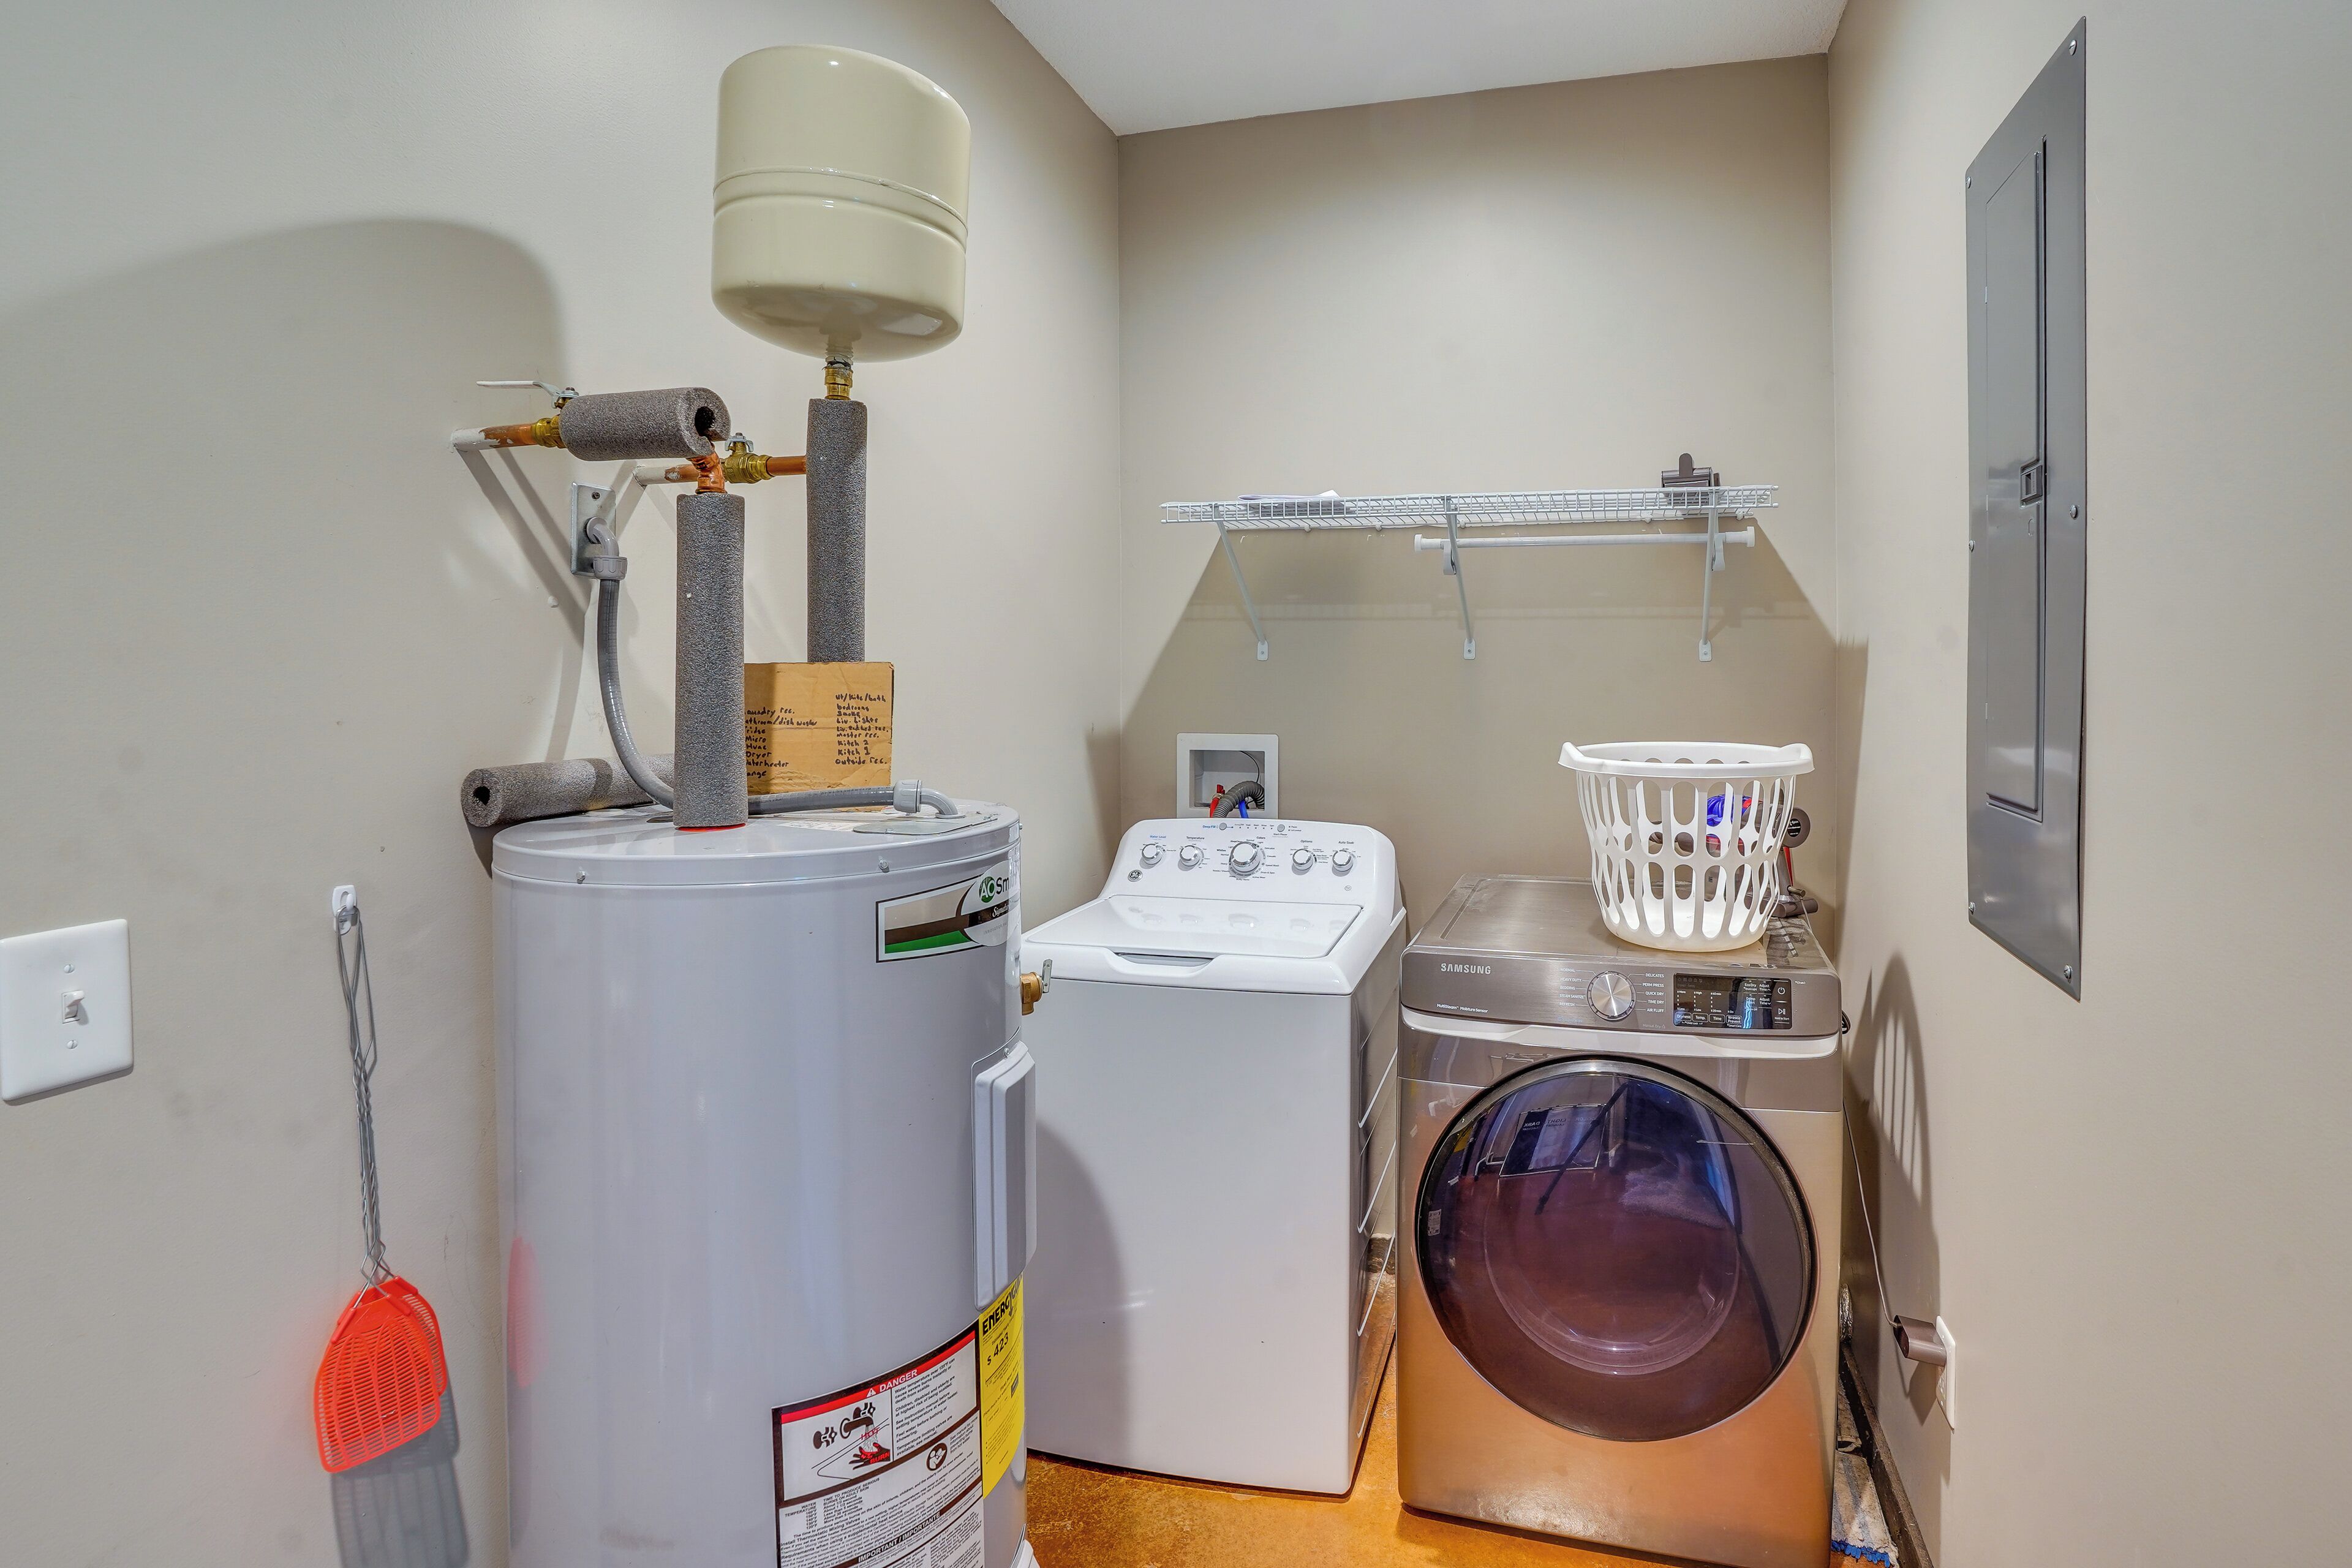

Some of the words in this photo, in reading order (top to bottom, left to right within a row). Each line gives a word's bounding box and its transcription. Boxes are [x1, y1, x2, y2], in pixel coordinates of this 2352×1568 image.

[745, 706, 776, 718] aundry
[745, 715, 794, 725] athroom/dish
[745, 725, 766, 734] ridge
[745, 751, 772, 760] Dryer
[747, 771, 767, 779] ange
[1441, 963, 1491, 974] SAMSUNG
[993, 1332, 1009, 1358] 423
[880, 1369, 918, 1392] DANGER
[870, 1451, 890, 1464] BURN
[785, 1506, 816, 1518] TEMPERATURE
[858, 1541, 899, 1562] IMPORTANT
[902, 1512, 941, 1542] IMPORTANTE
